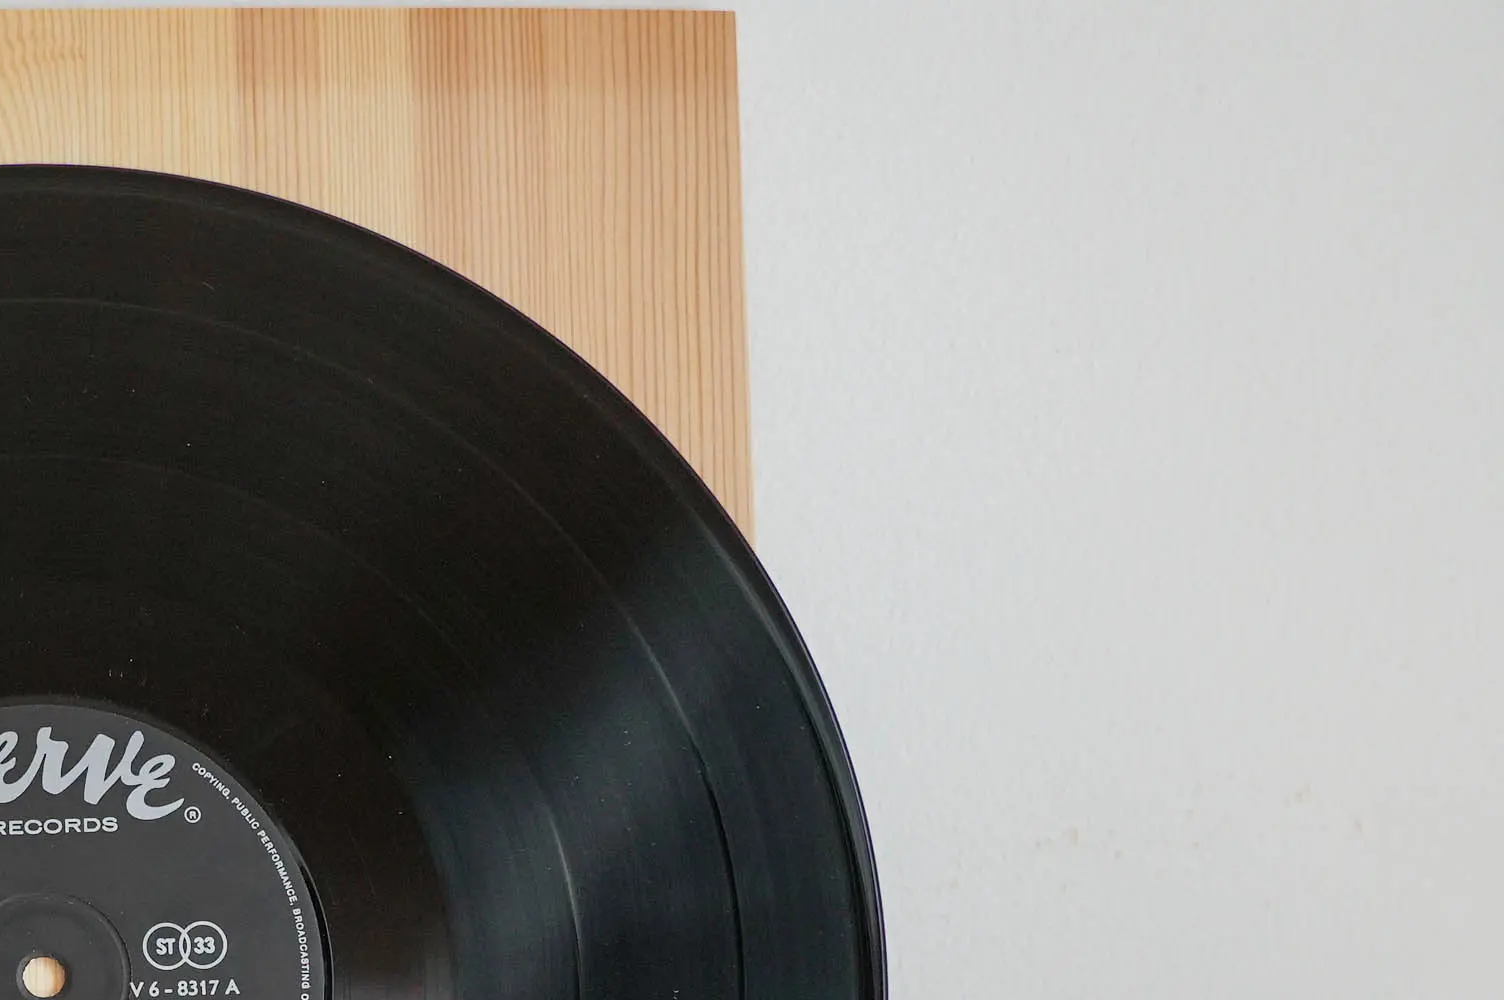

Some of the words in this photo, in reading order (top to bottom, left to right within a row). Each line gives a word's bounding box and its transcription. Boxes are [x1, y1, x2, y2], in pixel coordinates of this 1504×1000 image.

[191, 762, 231, 800] COPYING,
[230, 796, 260, 830] PUBLIC
[256, 829, 298, 906] PERFORMANCE,
[292, 907, 311, 990] BROADCASTING
[156, 938, 175, 955] ST
[194, 937, 215, 954] 33
[130, 981, 144, 998] V
[149, 981, 160, 997] 6
[177, 980, 219, 996] 8317
[225, 979, 240, 995] A
